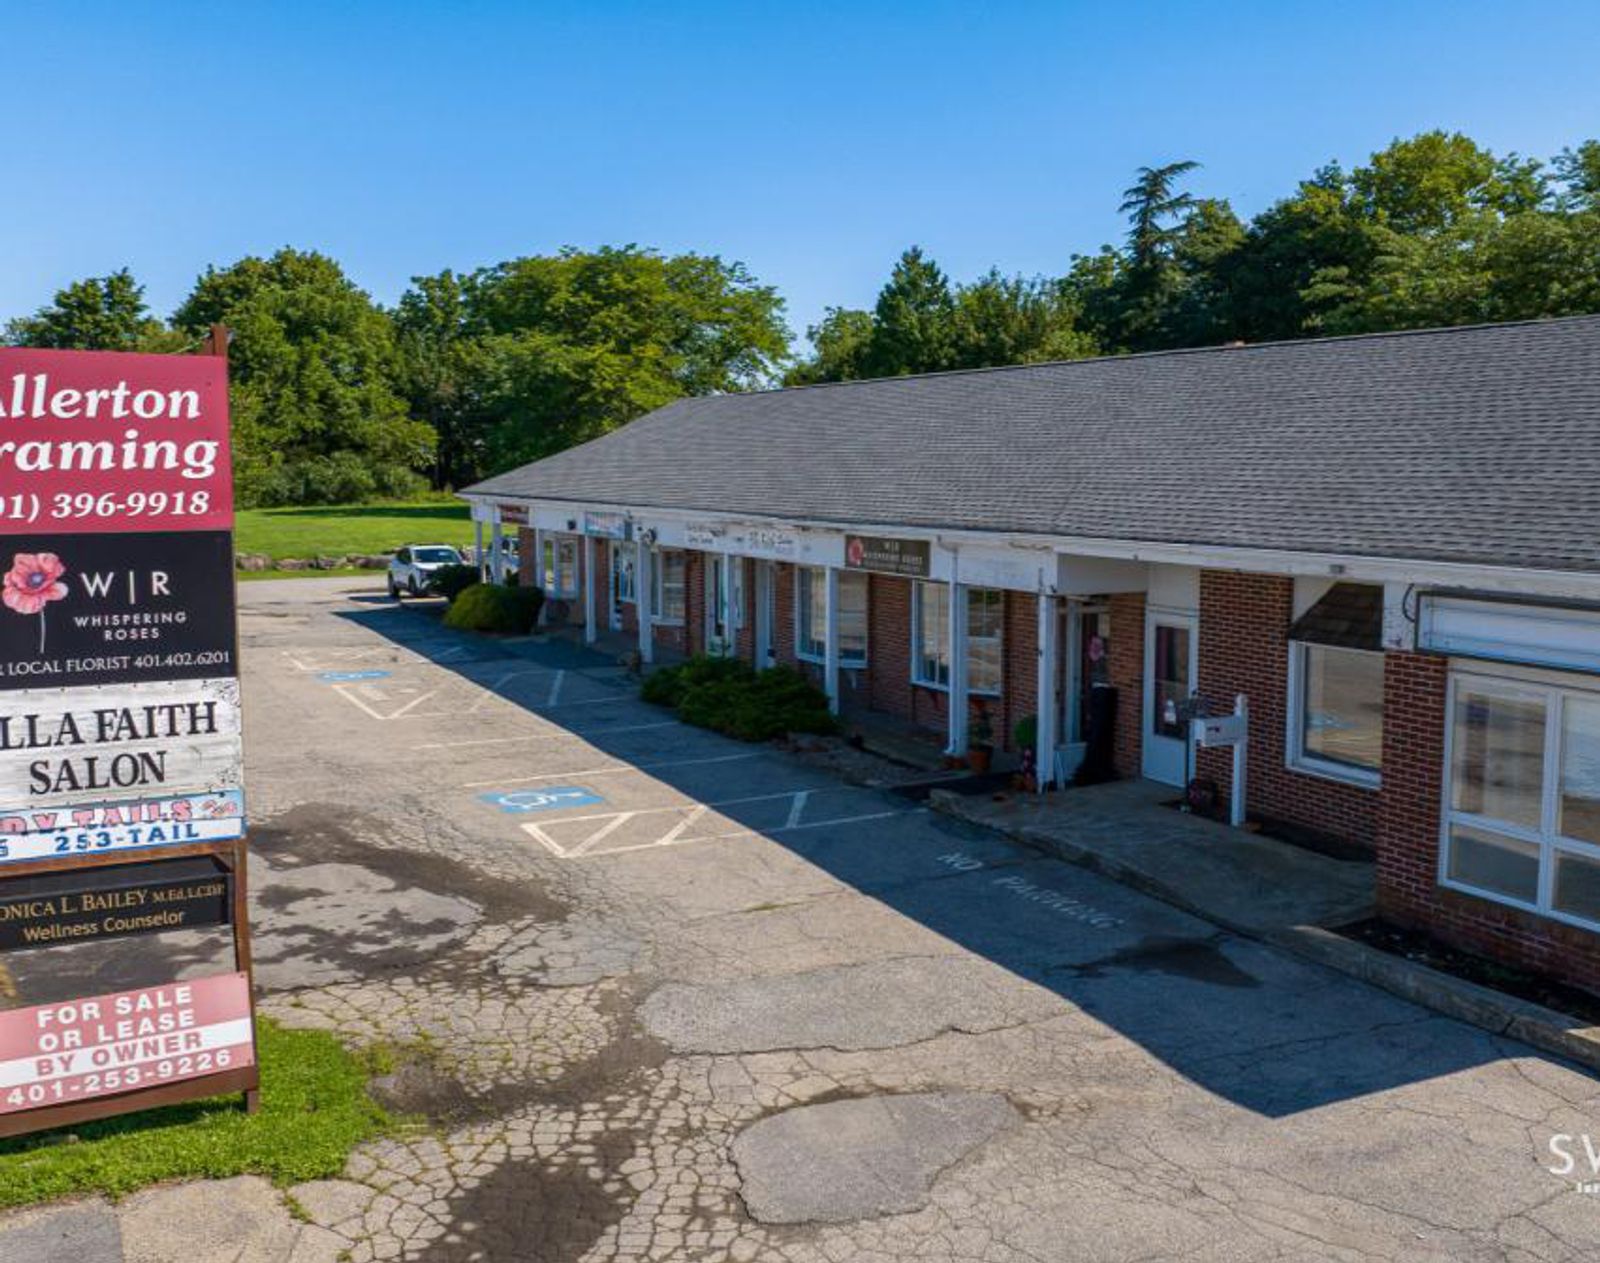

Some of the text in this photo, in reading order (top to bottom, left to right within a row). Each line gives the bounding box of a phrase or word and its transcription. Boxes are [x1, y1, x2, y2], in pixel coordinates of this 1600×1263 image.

[0, 374, 201, 418] llerton
[51, 491, 210, 518] 396-9918
[80, 571, 114, 598] W
[151, 571, 171, 596] R
[74, 611, 188, 628] WHISPERING
[104, 628, 160, 641] ROSES
[8, 659, 62, 676] LOCAL
[67, 656, 131, 672] FLORIST
[134, 651, 230, 668] 401.402.6201
[94, 701, 218, 743] FAITH
[30, 750, 167, 795] SALON
[72, 800, 192, 829] TAILS
[55, 823, 199, 852] 253-TAIL
[83, 889, 147, 911] BAILEY
[24, 910, 185, 941] Wellness Counselor
[37, 986, 192, 1028] FOR SALE
[39, 1009, 195, 1052] OR LEASE
[36, 1032, 203, 1077] BY OWNER
[7, 1048, 232, 1105] 401-253-9226
